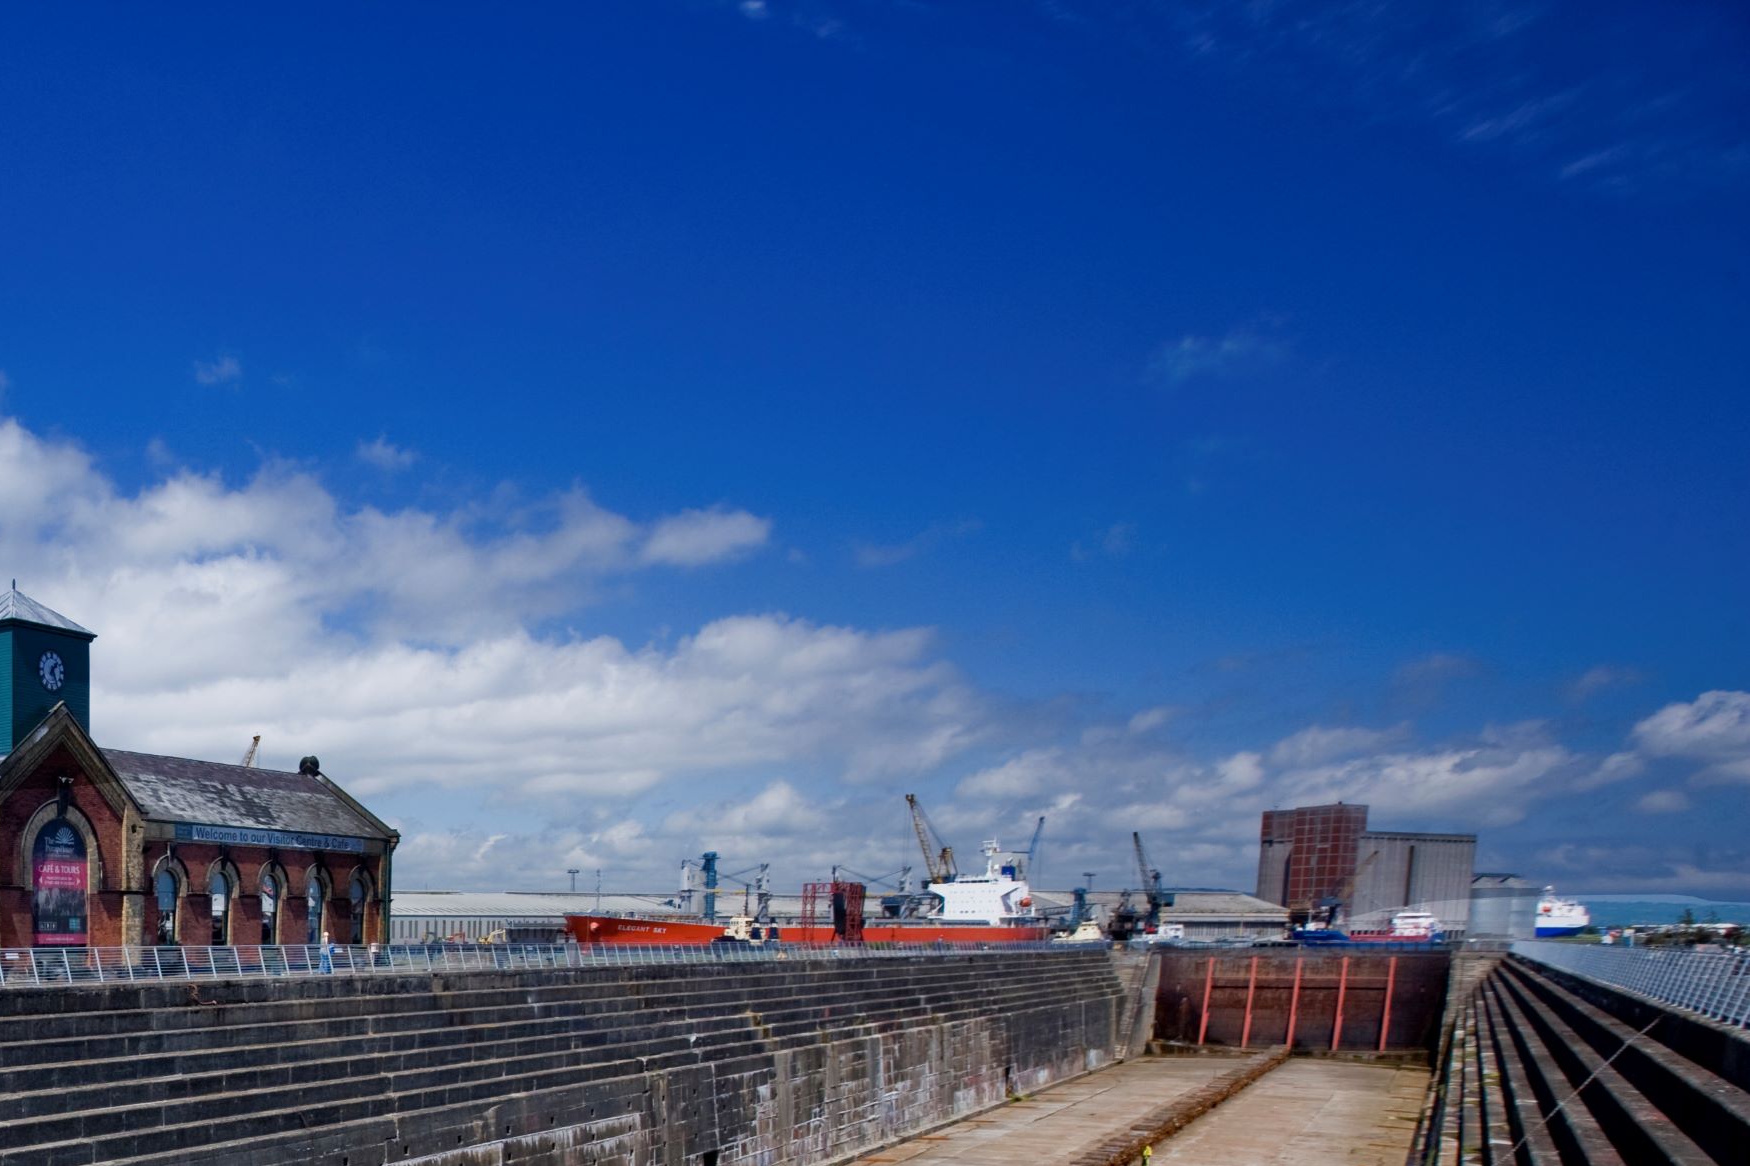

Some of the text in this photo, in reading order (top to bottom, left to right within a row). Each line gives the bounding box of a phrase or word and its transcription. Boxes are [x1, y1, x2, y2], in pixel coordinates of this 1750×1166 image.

[195, 827, 238, 841] Welcome
[239, 831, 248, 842] to
[250, 833, 266, 843] our
[267, 833, 294, 846] Visitor
[296, 835, 322, 847] Centre
[324, 838, 331, 848] &
[54, 865, 60, 874] &
[61, 865, 80, 874] TOURS
